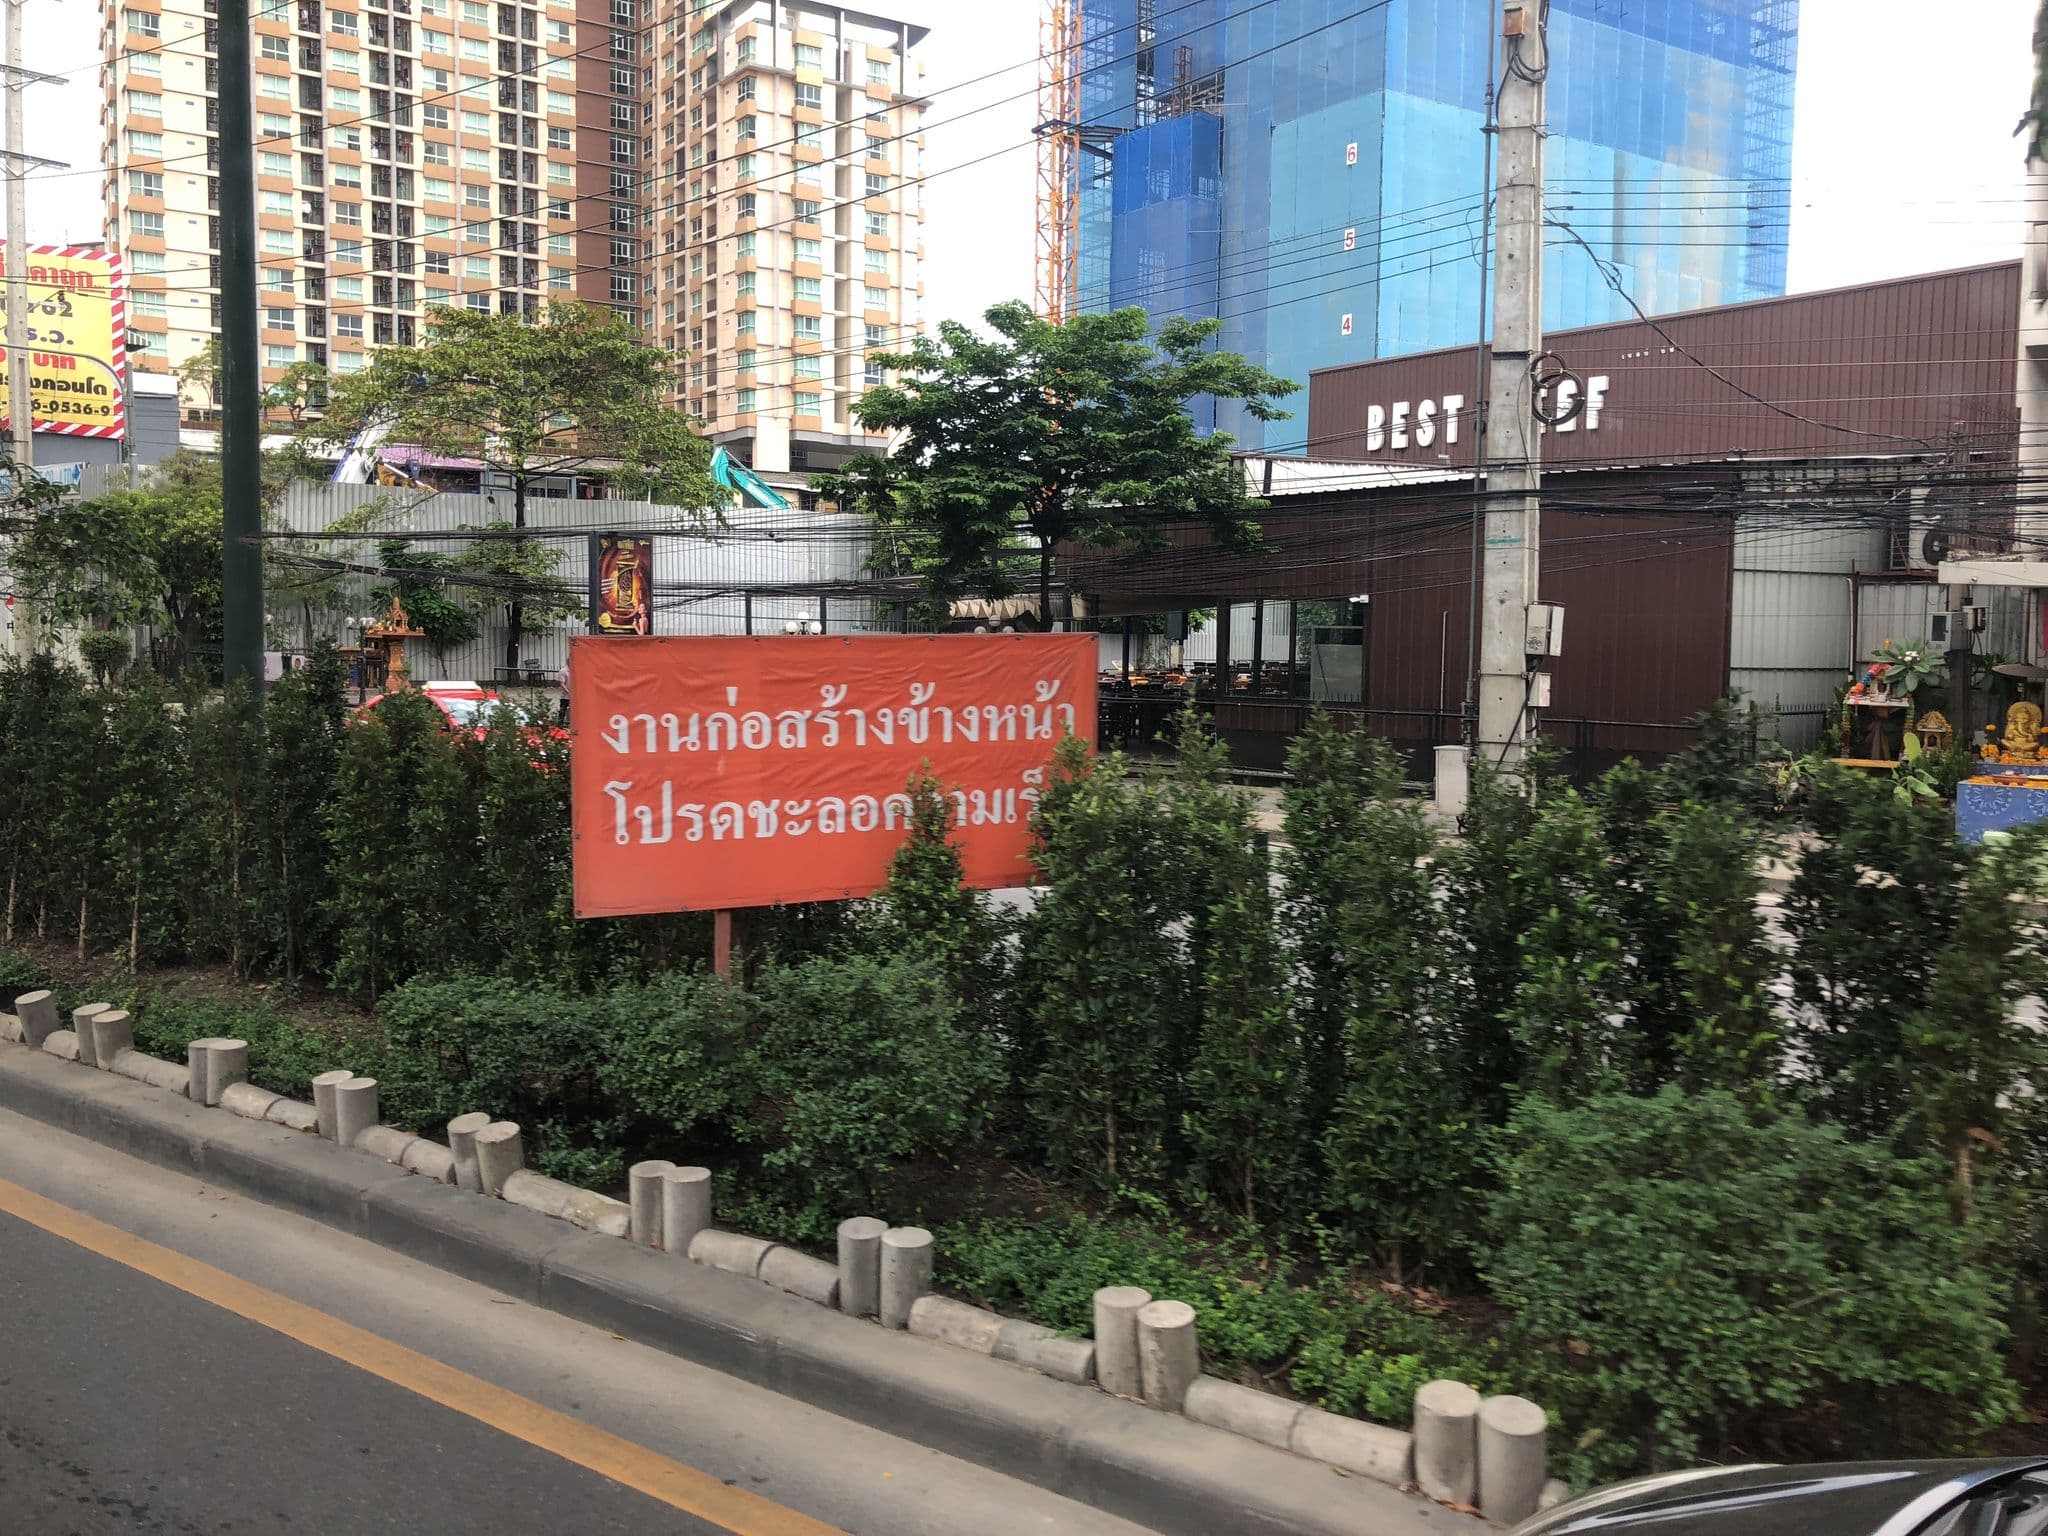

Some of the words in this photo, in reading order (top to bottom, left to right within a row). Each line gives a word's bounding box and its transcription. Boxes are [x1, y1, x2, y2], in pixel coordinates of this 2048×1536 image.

[1347, 146, 1356, 162] 6
[1345, 232, 1354, 248] 5
[1342, 317, 1351, 333] 4
[1367, 394, 1464, 451] BEST
[601, 679, 1076, 754] งานก่อสร้างข้างหน้า
[603, 765, 1044, 846] โปรดชะลอคามเร็
